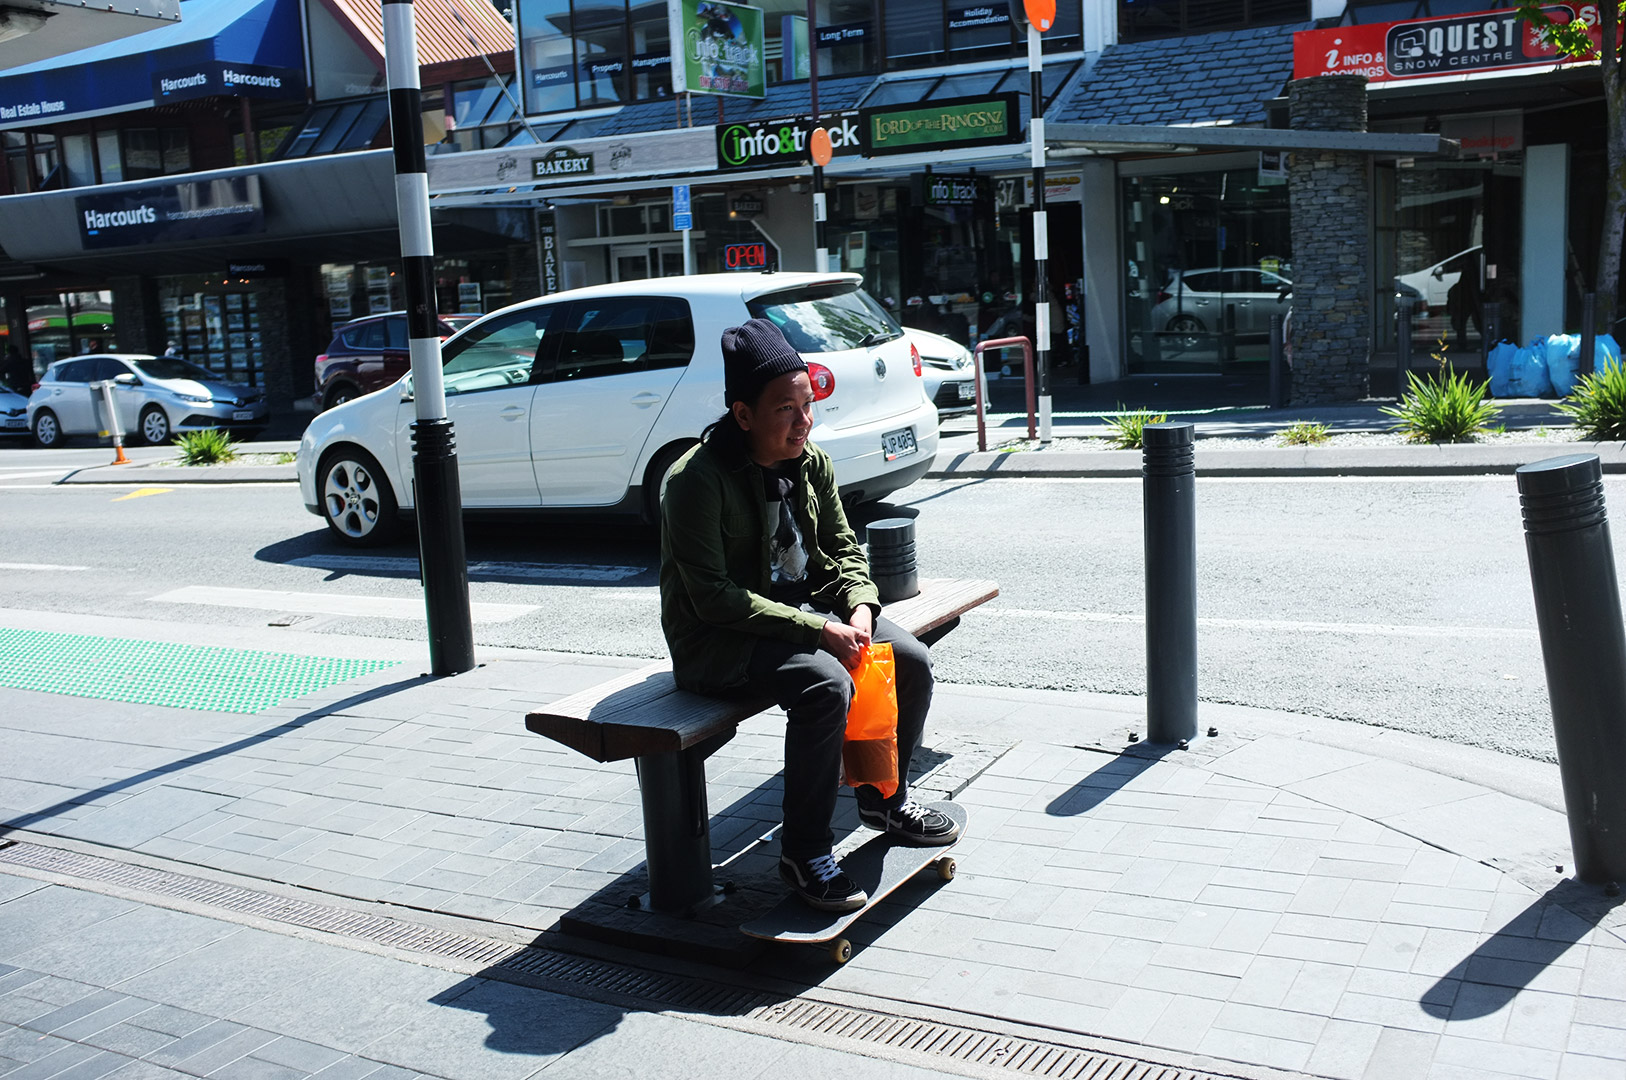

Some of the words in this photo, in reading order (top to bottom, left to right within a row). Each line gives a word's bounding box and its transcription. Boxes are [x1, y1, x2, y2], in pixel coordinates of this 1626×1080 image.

[948, 14, 1010, 29] Accommodation
[963, 7, 993, 18] Holiday
[820, 31, 842, 41] Long
[843, 27, 865, 37] Term
[1429, 18, 1516, 57] QUEST
[592, 62, 623, 74] Property
[632, 56, 672, 67] Manageme
[1343, 53, 1373, 66] INFO
[1375, 52, 1385, 63] &
[1394, 59, 1442, 71] SNOW
[1449, 51, 1513, 66] CENTRE
[161, 72, 206, 92] Harcourts
[223, 69, 281, 88] Harcourts
[0, 106, 17, 119] Real
[17, 103, 41, 117] Estate
[41, 101, 65, 113] House
[876, 117, 911, 141] LORD
[722, 119, 860, 164] info&trck
[535, 157, 590, 175] BAKERY
[84, 205, 156, 229] Harcourts
[543, 236, 557, 295] BAKE
[726, 245, 765, 267] OPEN
